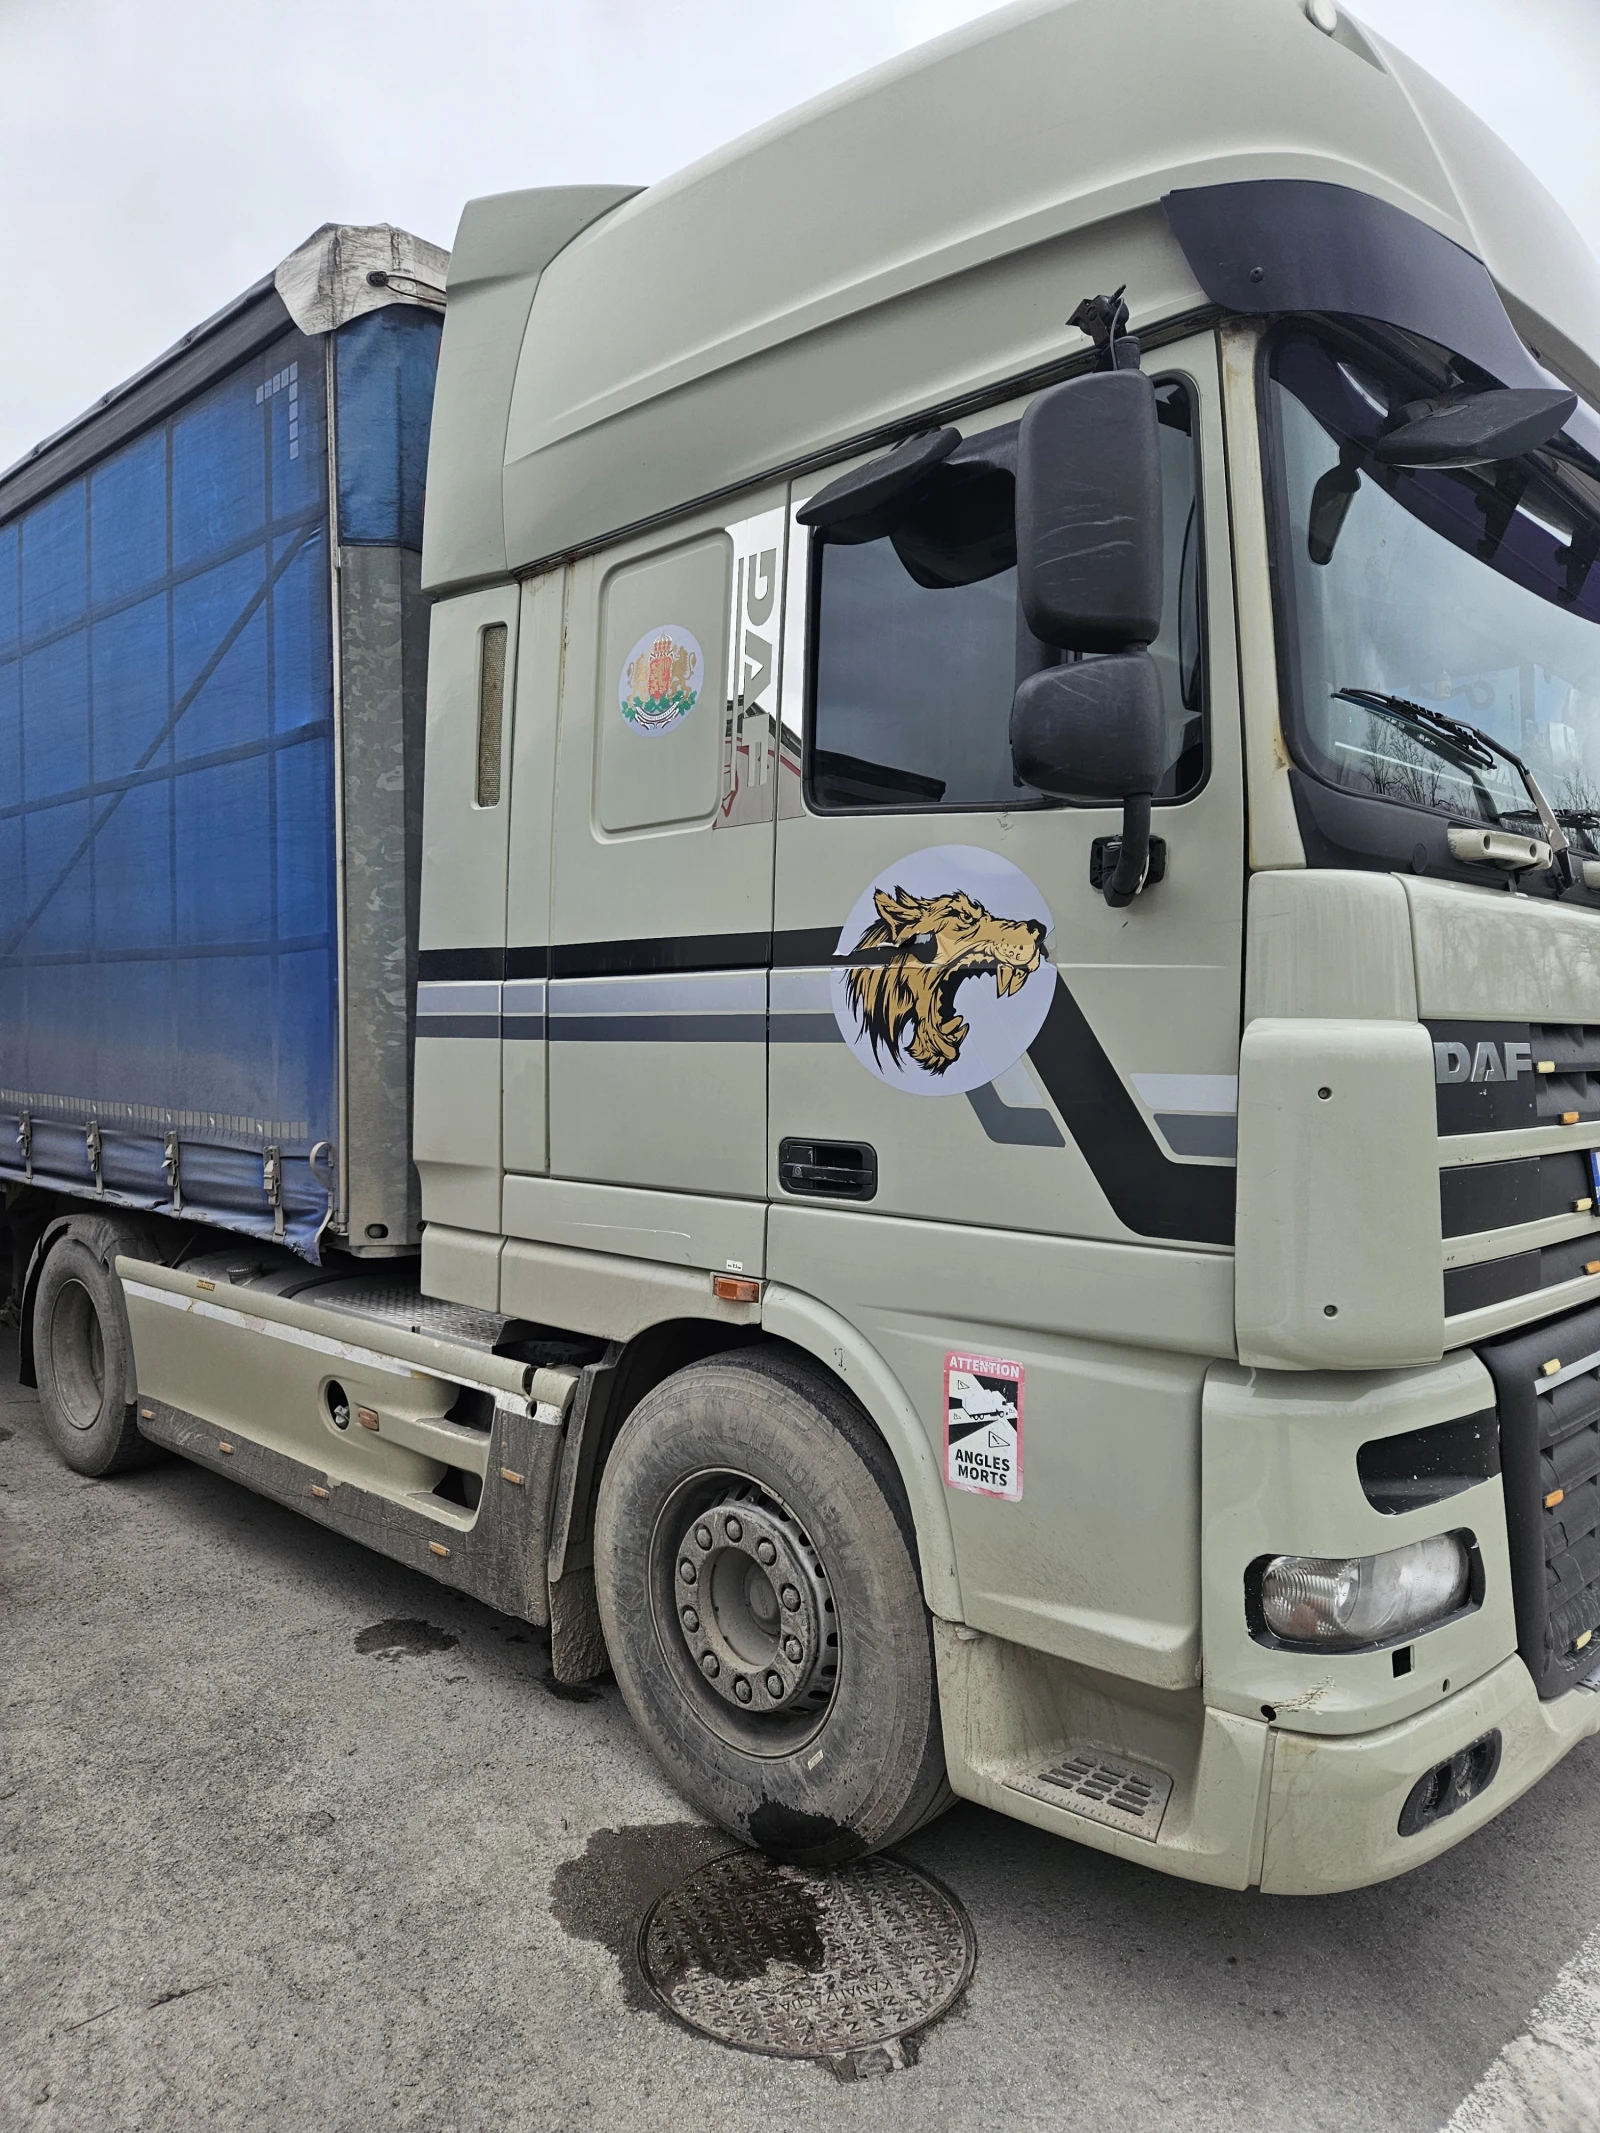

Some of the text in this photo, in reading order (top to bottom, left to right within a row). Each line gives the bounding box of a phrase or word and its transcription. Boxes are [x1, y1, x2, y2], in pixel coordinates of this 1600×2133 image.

[741, 548, 777, 788] DAF
[1433, 1041, 1532, 1084] DAF
[949, 1355, 1020, 1378] ATTENTION
[955, 1448, 1011, 1472] ANGLES
[957, 1464, 1008, 1487] MORTS
